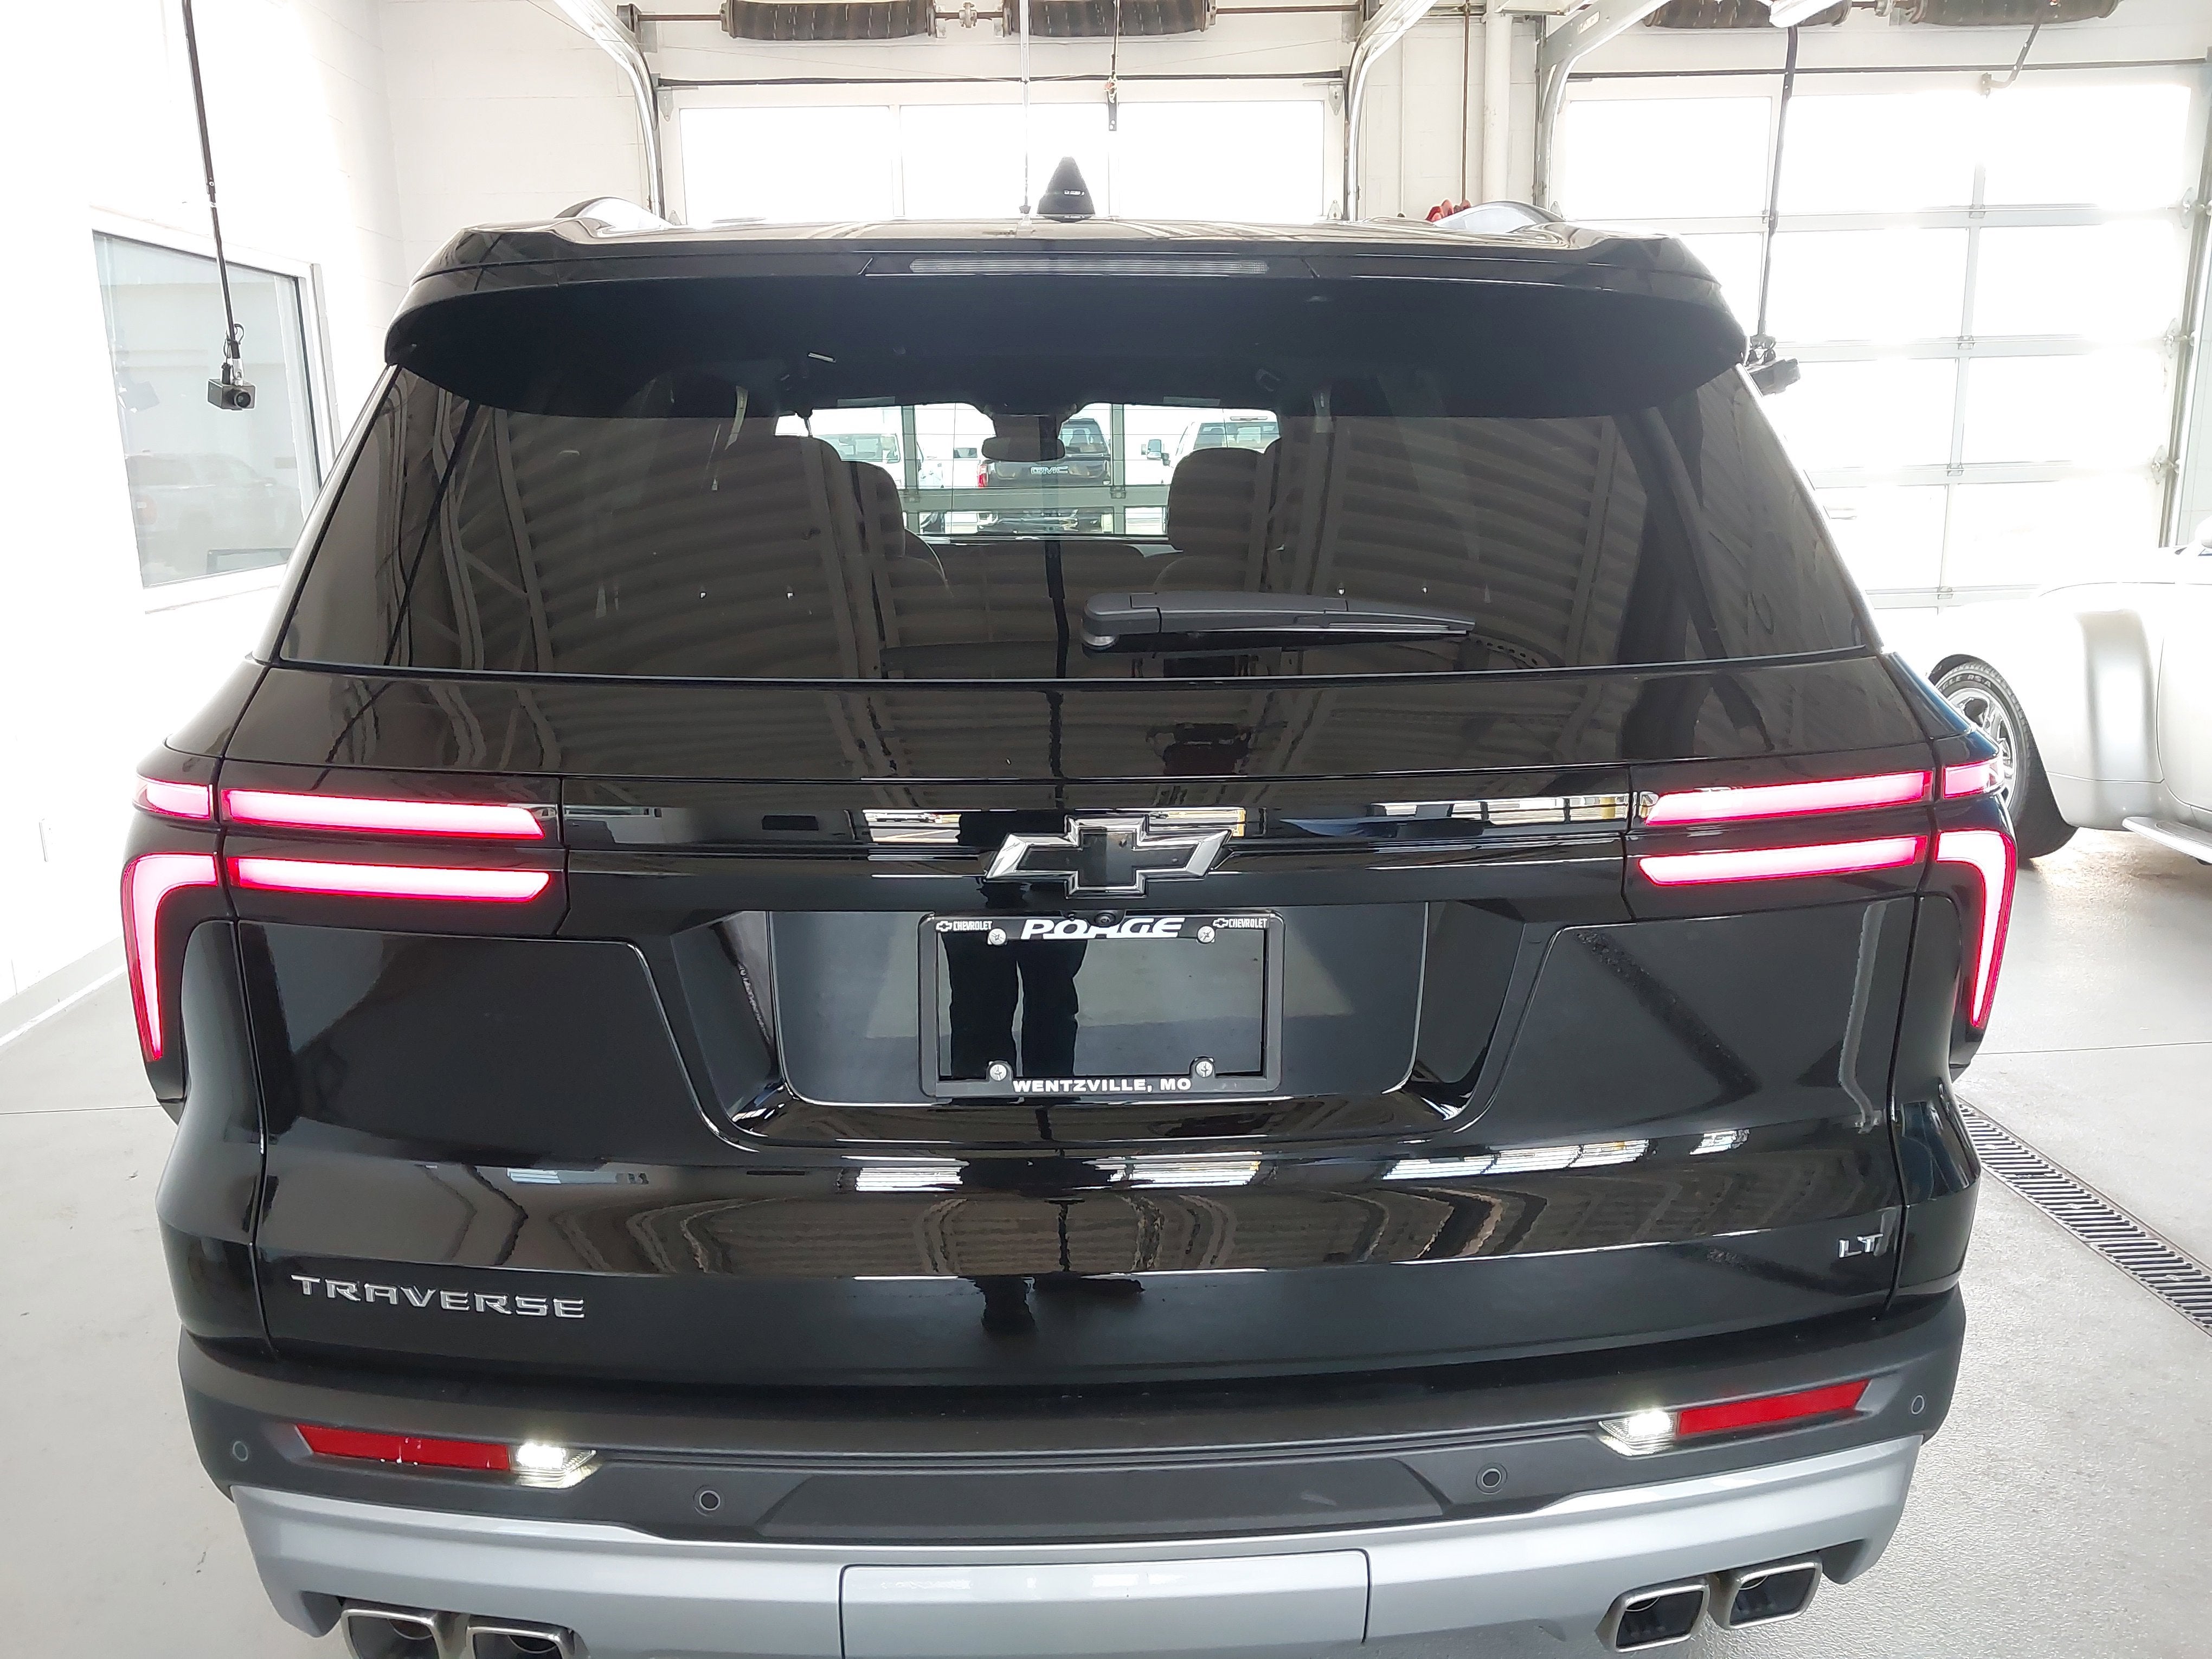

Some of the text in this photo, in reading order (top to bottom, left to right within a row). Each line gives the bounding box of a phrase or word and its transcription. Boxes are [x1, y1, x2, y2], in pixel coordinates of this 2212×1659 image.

[1031, 466, 1069, 474] GMC
[953, 921, 993, 931] CHEVROLET
[1229, 918, 1268, 928] CHEVROLET
[1013, 1078, 1191, 1092] WENTZVILLE, MO
[1838, 1233, 1883, 1258] LT
[291, 1274, 586, 1319] TRAVERSE
